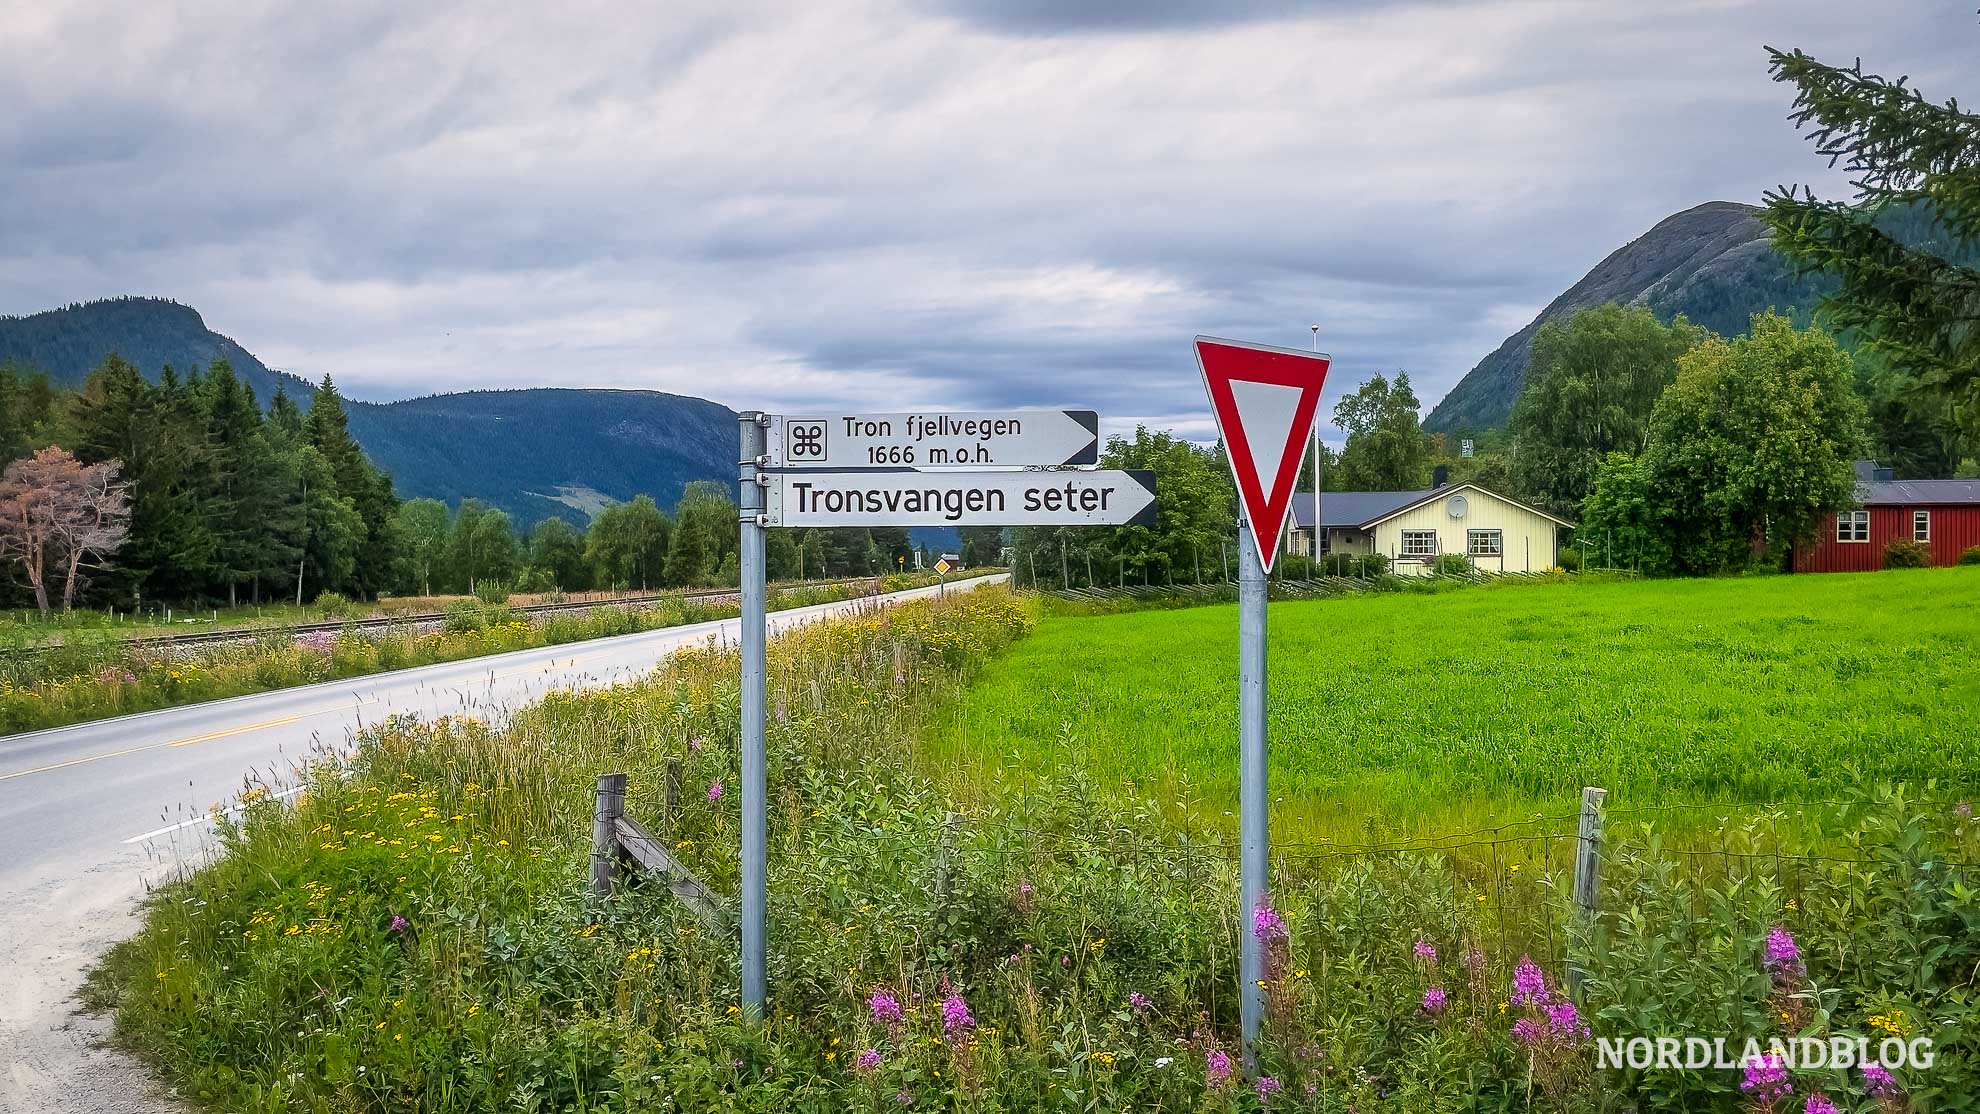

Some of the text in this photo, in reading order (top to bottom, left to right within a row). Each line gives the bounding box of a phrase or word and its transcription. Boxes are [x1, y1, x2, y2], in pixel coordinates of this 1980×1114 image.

[842, 415, 1022, 442] Tron fjellvegen
[868, 443, 994, 464] 1666 m.o.h.
[792, 481, 1115, 521] Tronsvangen seter
